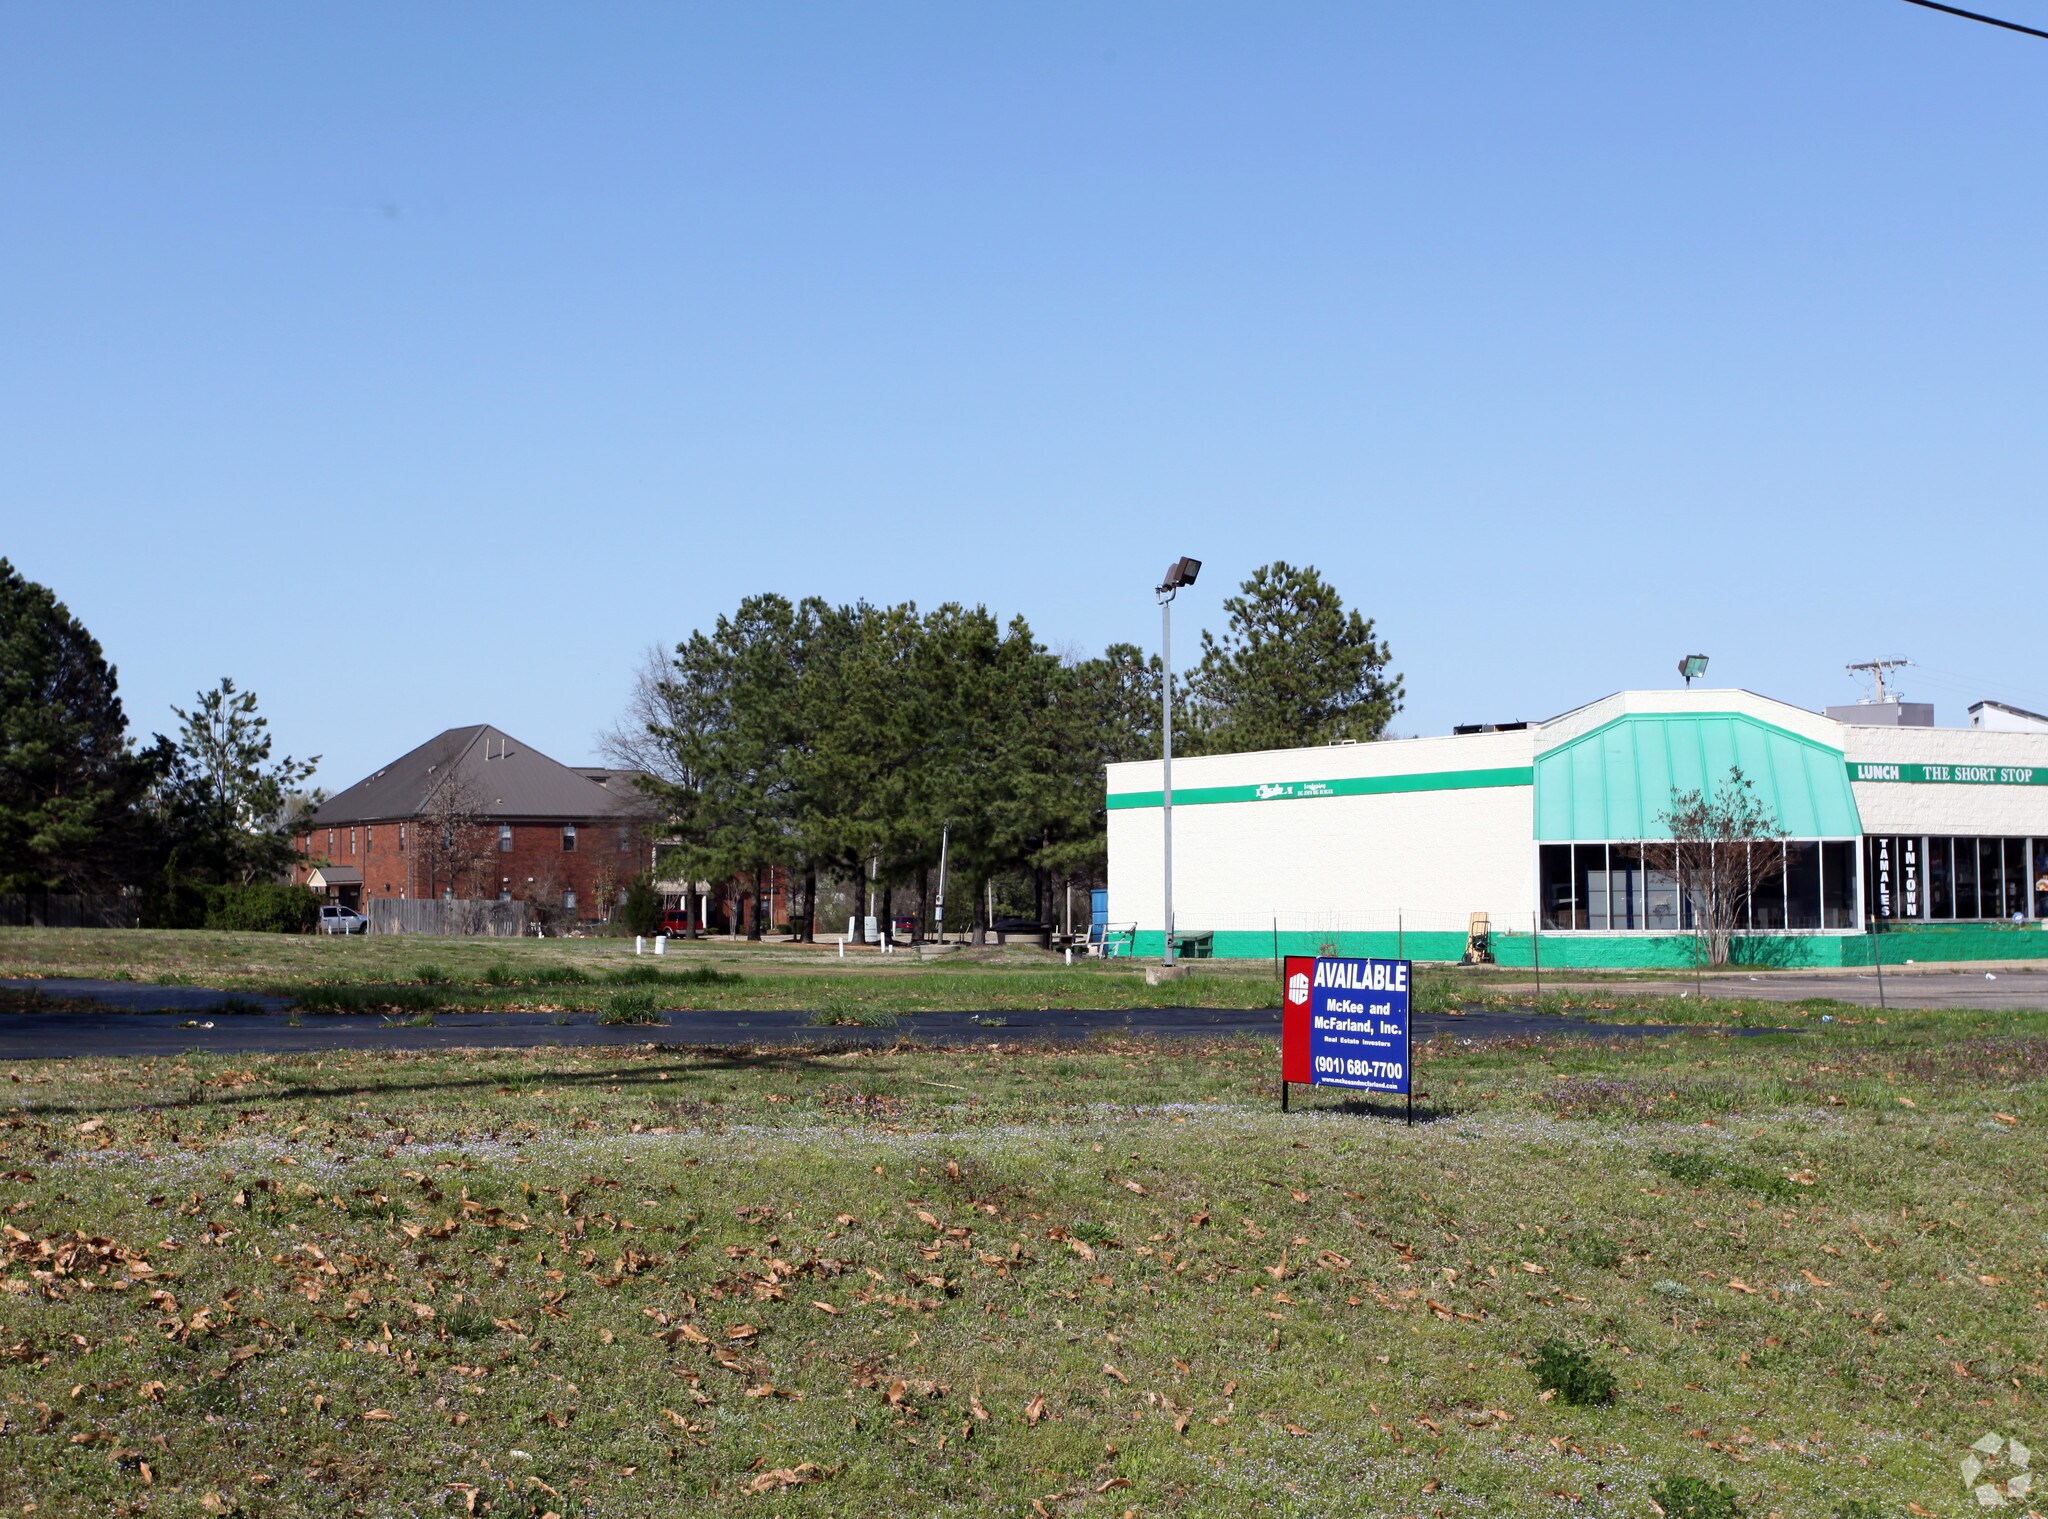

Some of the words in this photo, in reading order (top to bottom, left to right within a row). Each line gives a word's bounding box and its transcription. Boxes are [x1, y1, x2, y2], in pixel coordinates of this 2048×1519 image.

[1857, 764, 1899, 780] LUNCH
[1922, 766, 1950, 780] THE
[1955, 767, 1996, 781] SHORT
[2000, 768, 2033, 782] STOP
[1879, 839, 1890, 917] TAMALES
[1313, 962, 1407, 992] AVAILABLE
[1326, 998, 1364, 1013] McKee
[1369, 1002, 1390, 1015] and
[1314, 1016, 1374, 1036] McFarland,
[1380, 1020, 1402, 1035] Inc.
[1324, 1035, 1338, 1043] Real
[1340, 1037, 1360, 1045] Estate
[1362, 1039, 1391, 1047] Investors
[1315, 1056, 1344, 1075] (901)
[1346, 1059, 1403, 1080] 680-7700
